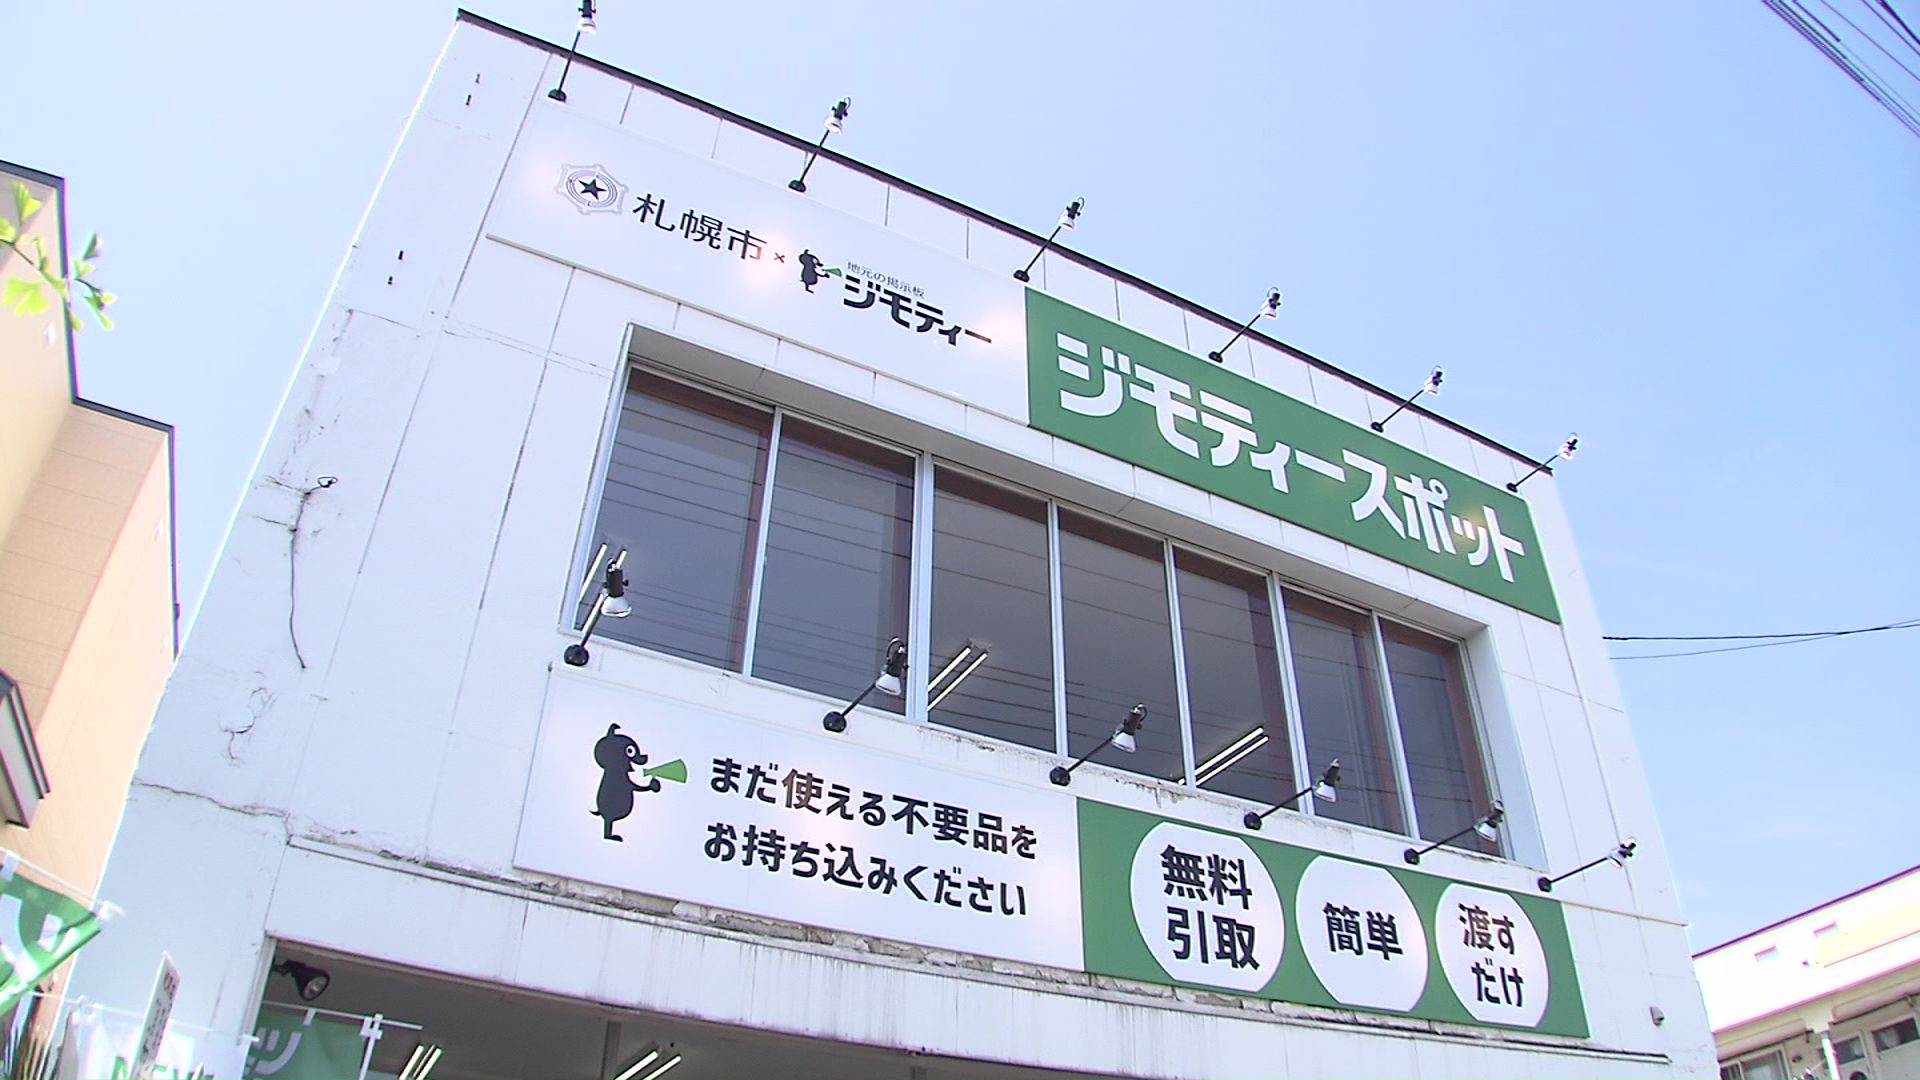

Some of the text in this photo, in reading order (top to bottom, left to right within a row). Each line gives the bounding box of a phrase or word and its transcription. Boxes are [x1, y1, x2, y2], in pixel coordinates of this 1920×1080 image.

[632, 193, 768, 260] 札幌市
[843, 274, 993, 347] ジモティー
[847, 261, 925, 299] 地元の掲示板
[1056, 332, 1525, 583] ジモティースポット
[709, 757, 1038, 860] まだ使える不要品を
[703, 821, 1028, 916] お持ち込みください
[1160, 844, 1253, 911] 無料
[1166, 906, 1260, 971] 引取
[1322, 901, 1404, 961] 簡単
[1458, 902, 1516, 955] 渡す
[1471, 958, 1525, 1008] だけ
